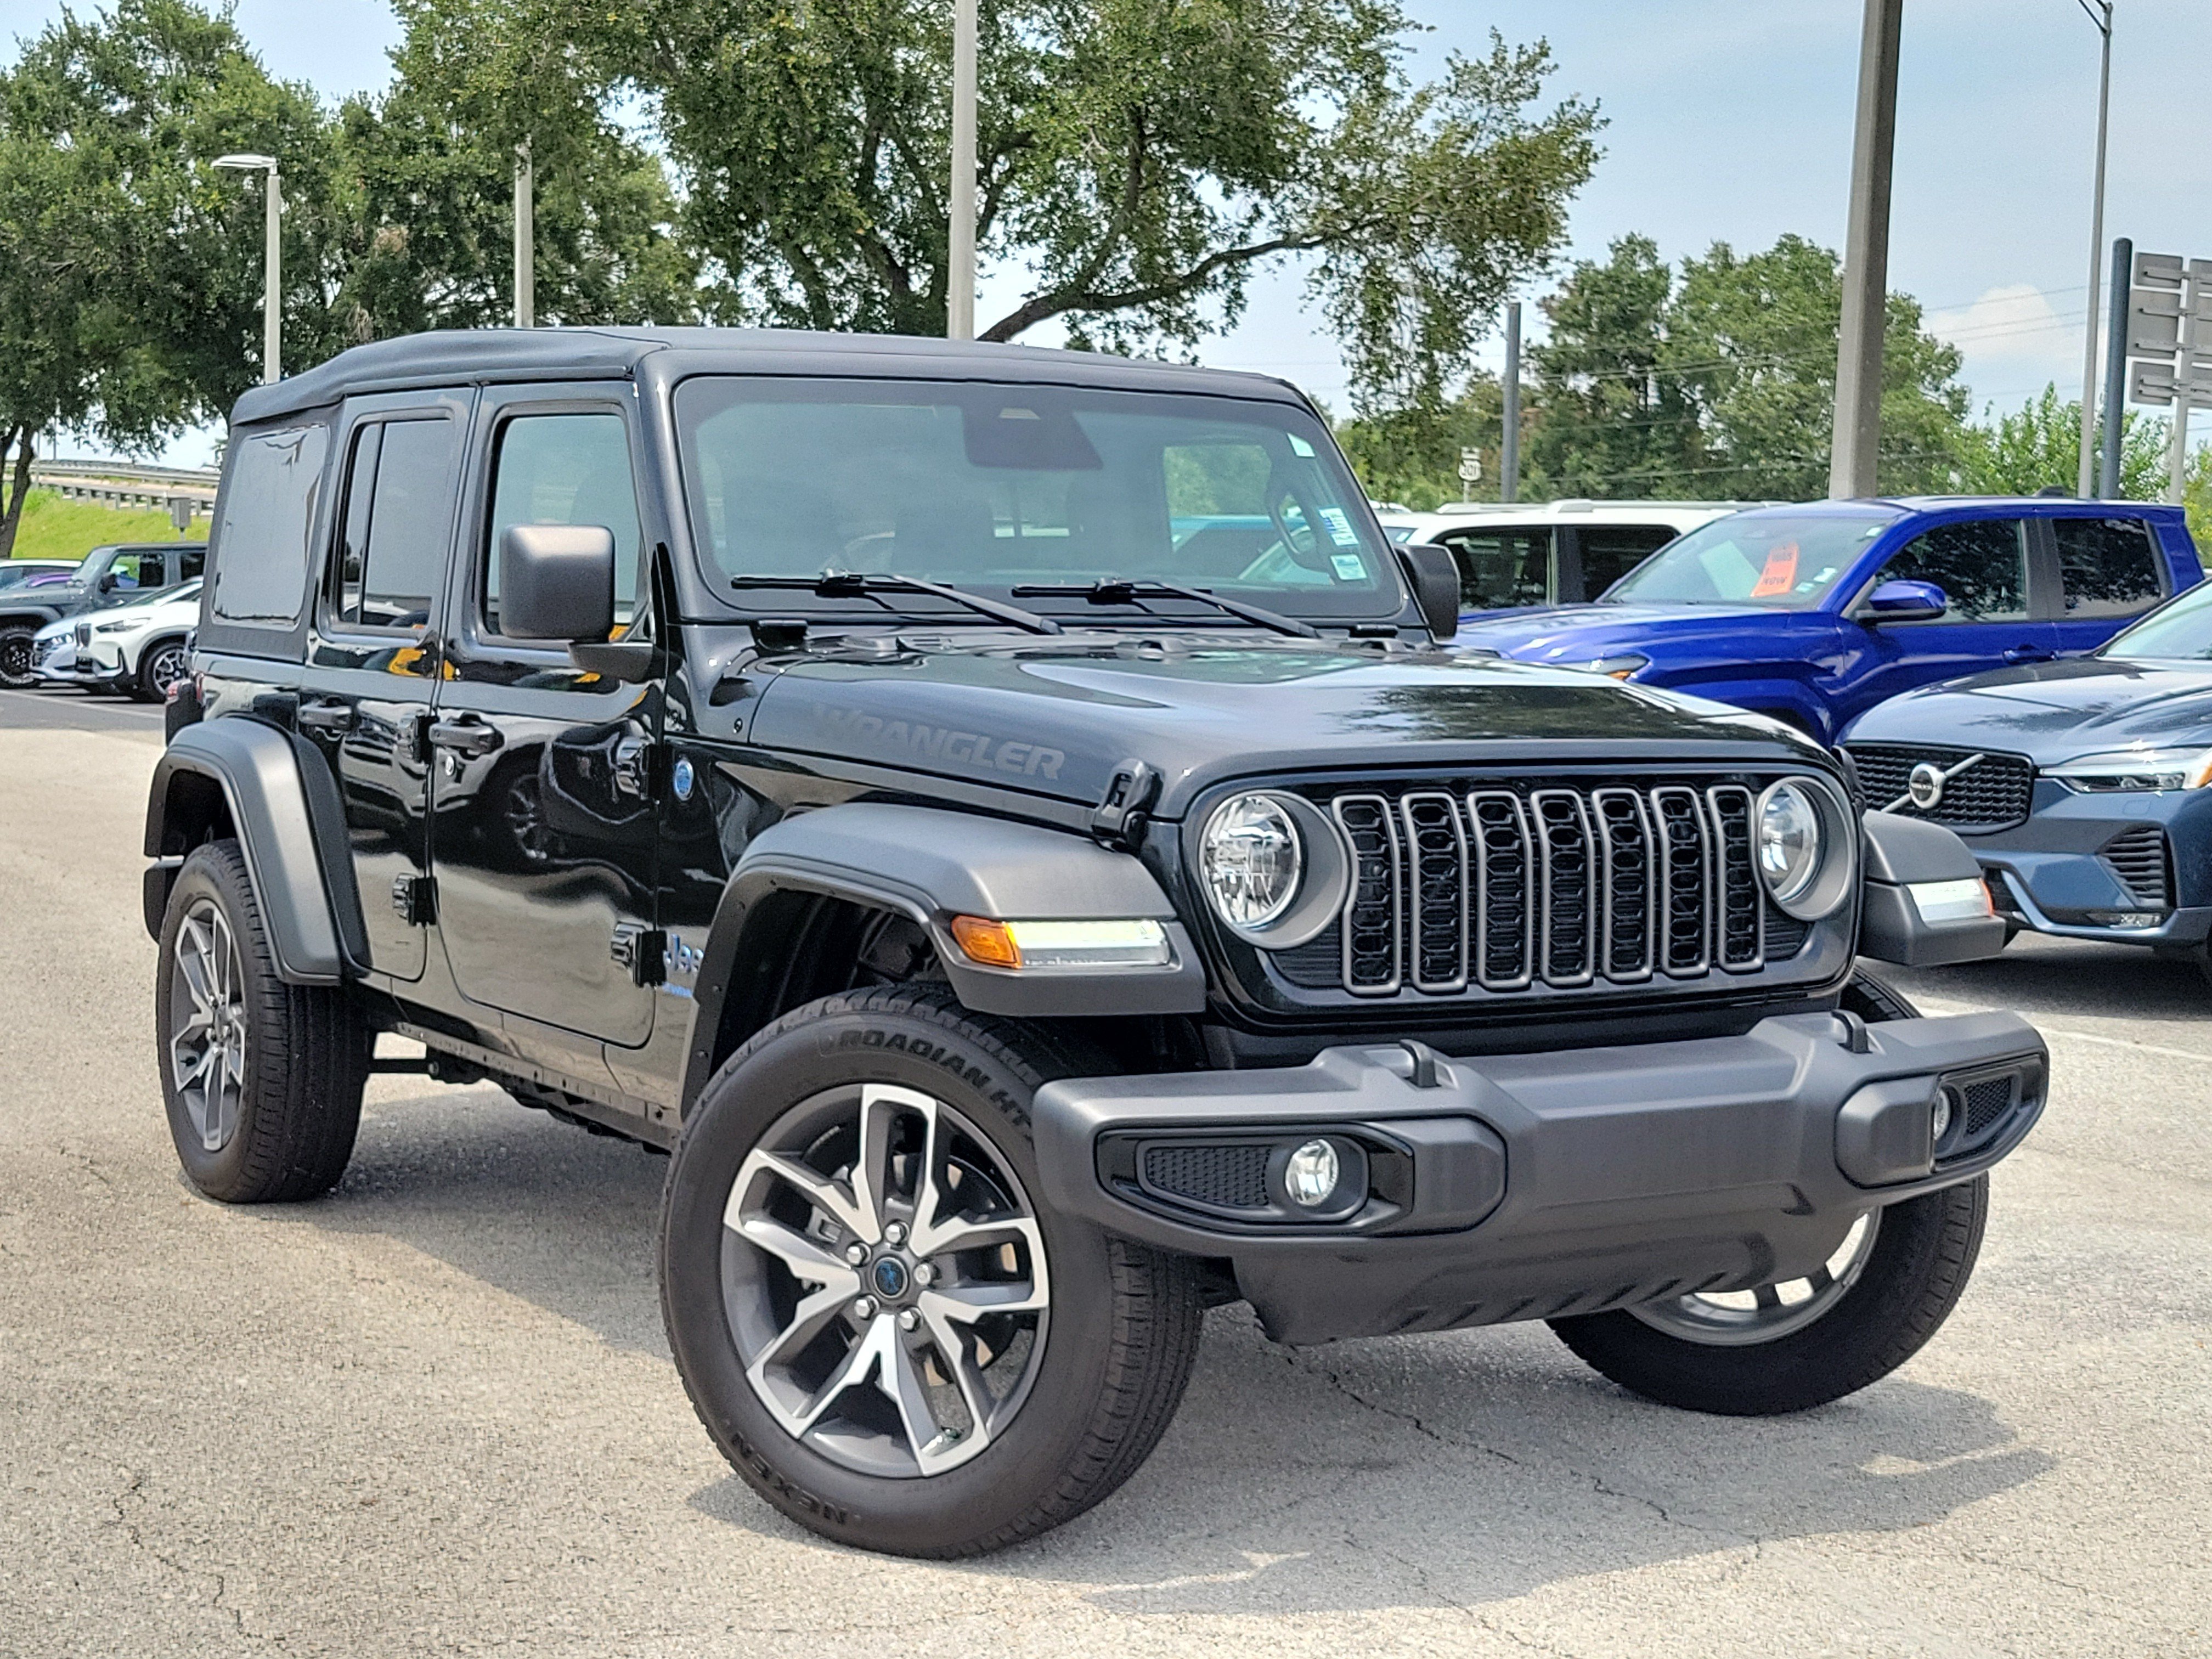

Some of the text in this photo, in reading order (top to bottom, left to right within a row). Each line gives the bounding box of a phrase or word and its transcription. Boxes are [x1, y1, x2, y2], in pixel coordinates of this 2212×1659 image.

[813, 704, 1065, 781] WRANGLER
[663, 934, 704, 973] Jee
[839, 1029, 992, 1088] ROADIAN
[732, 1431, 848, 1525] NEXEN
